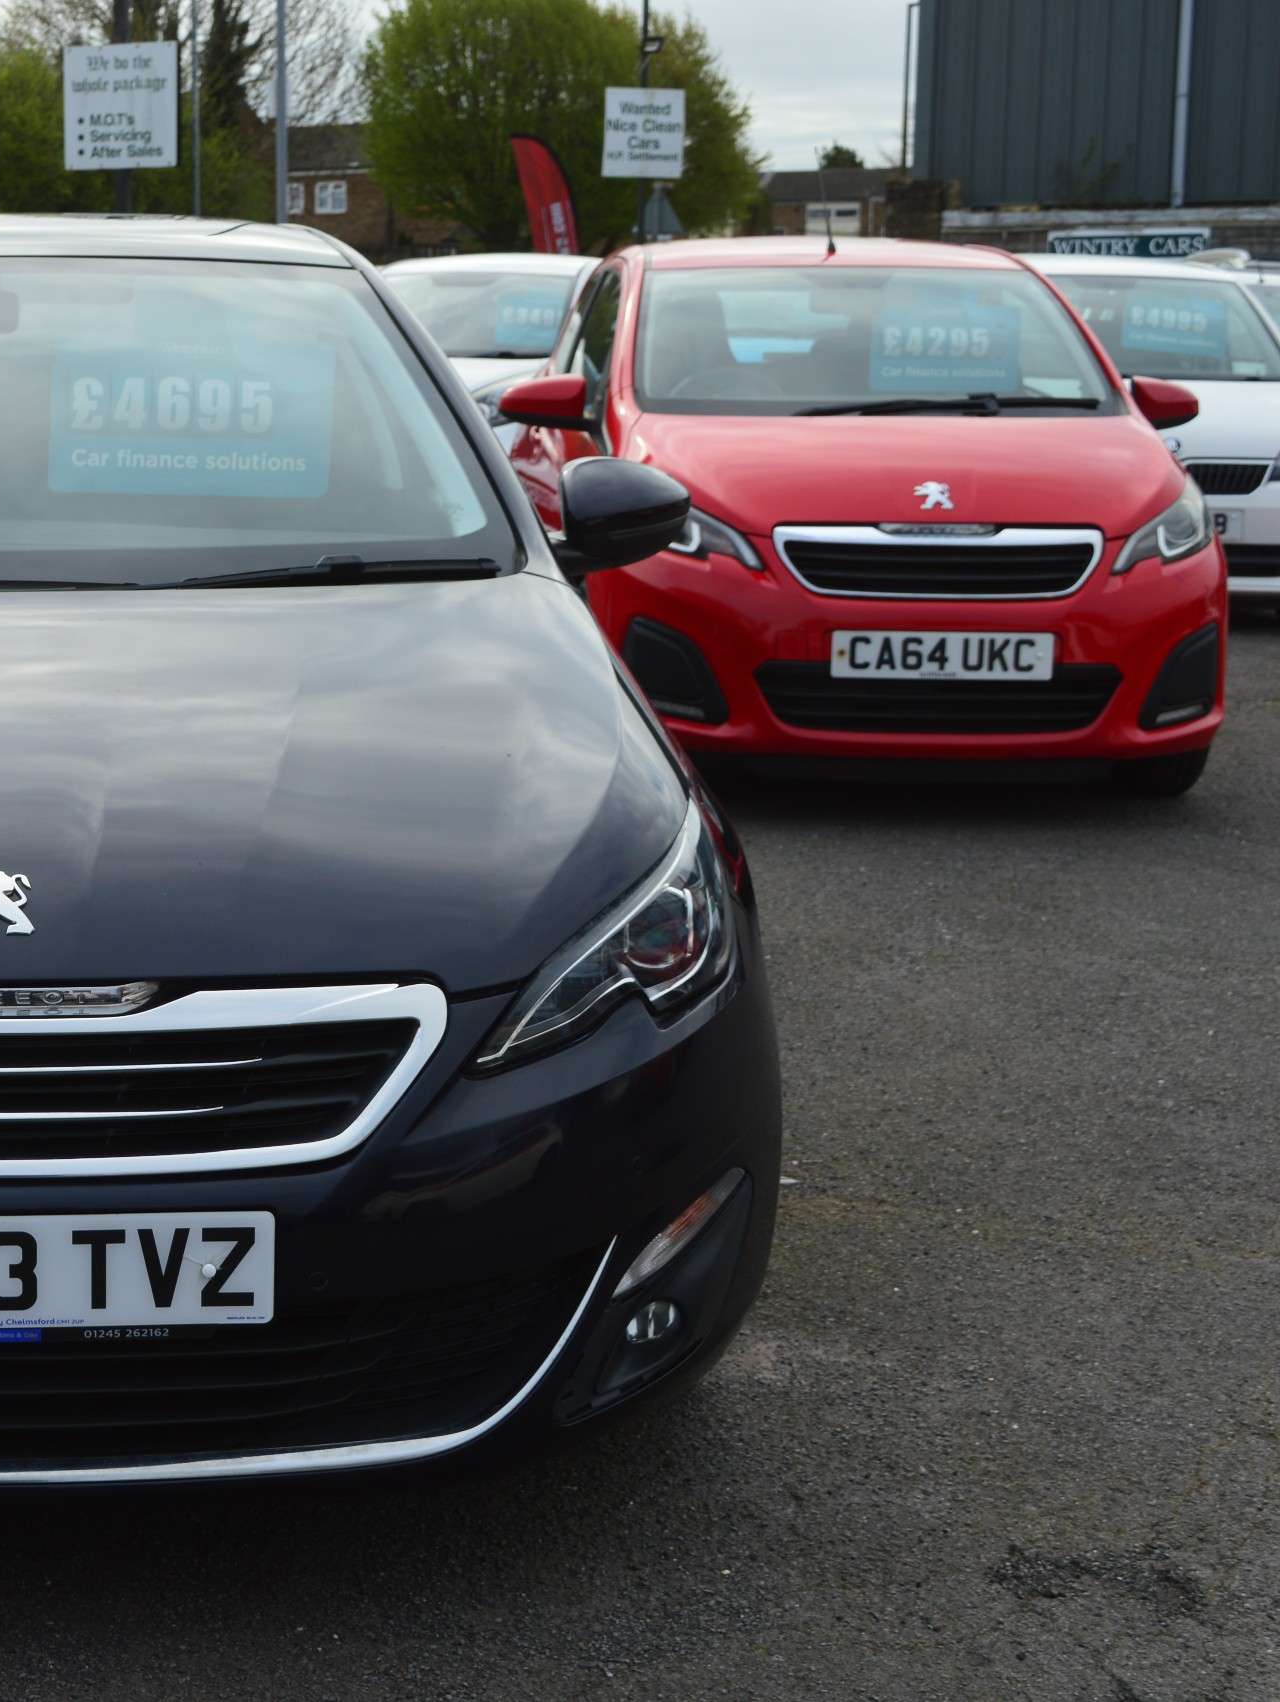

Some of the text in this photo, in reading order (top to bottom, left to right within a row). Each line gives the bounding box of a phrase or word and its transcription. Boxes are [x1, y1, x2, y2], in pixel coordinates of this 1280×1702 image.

[113, 76, 167, 92] package
[620, 102, 672, 115] Wanted
[606, 119, 681, 132] Nice Clean
[90, 129, 152, 144] Servicing
[627, 136, 661, 149] Cars
[90, 144, 163, 158] After Sales
[1053, 235, 1205, 256] WINTRY CARS
[881, 326, 990, 357] £4295
[71, 376, 273, 433] £4695
[71, 449, 307, 472] Car finance solutions
[849, 636, 1036, 673] CA64 UKC
[72, 1226, 256, 1309] TVZ
[5, 1317, 56, 1327] Chelmsford
[84, 1328, 170, 1338] 01245 262162
